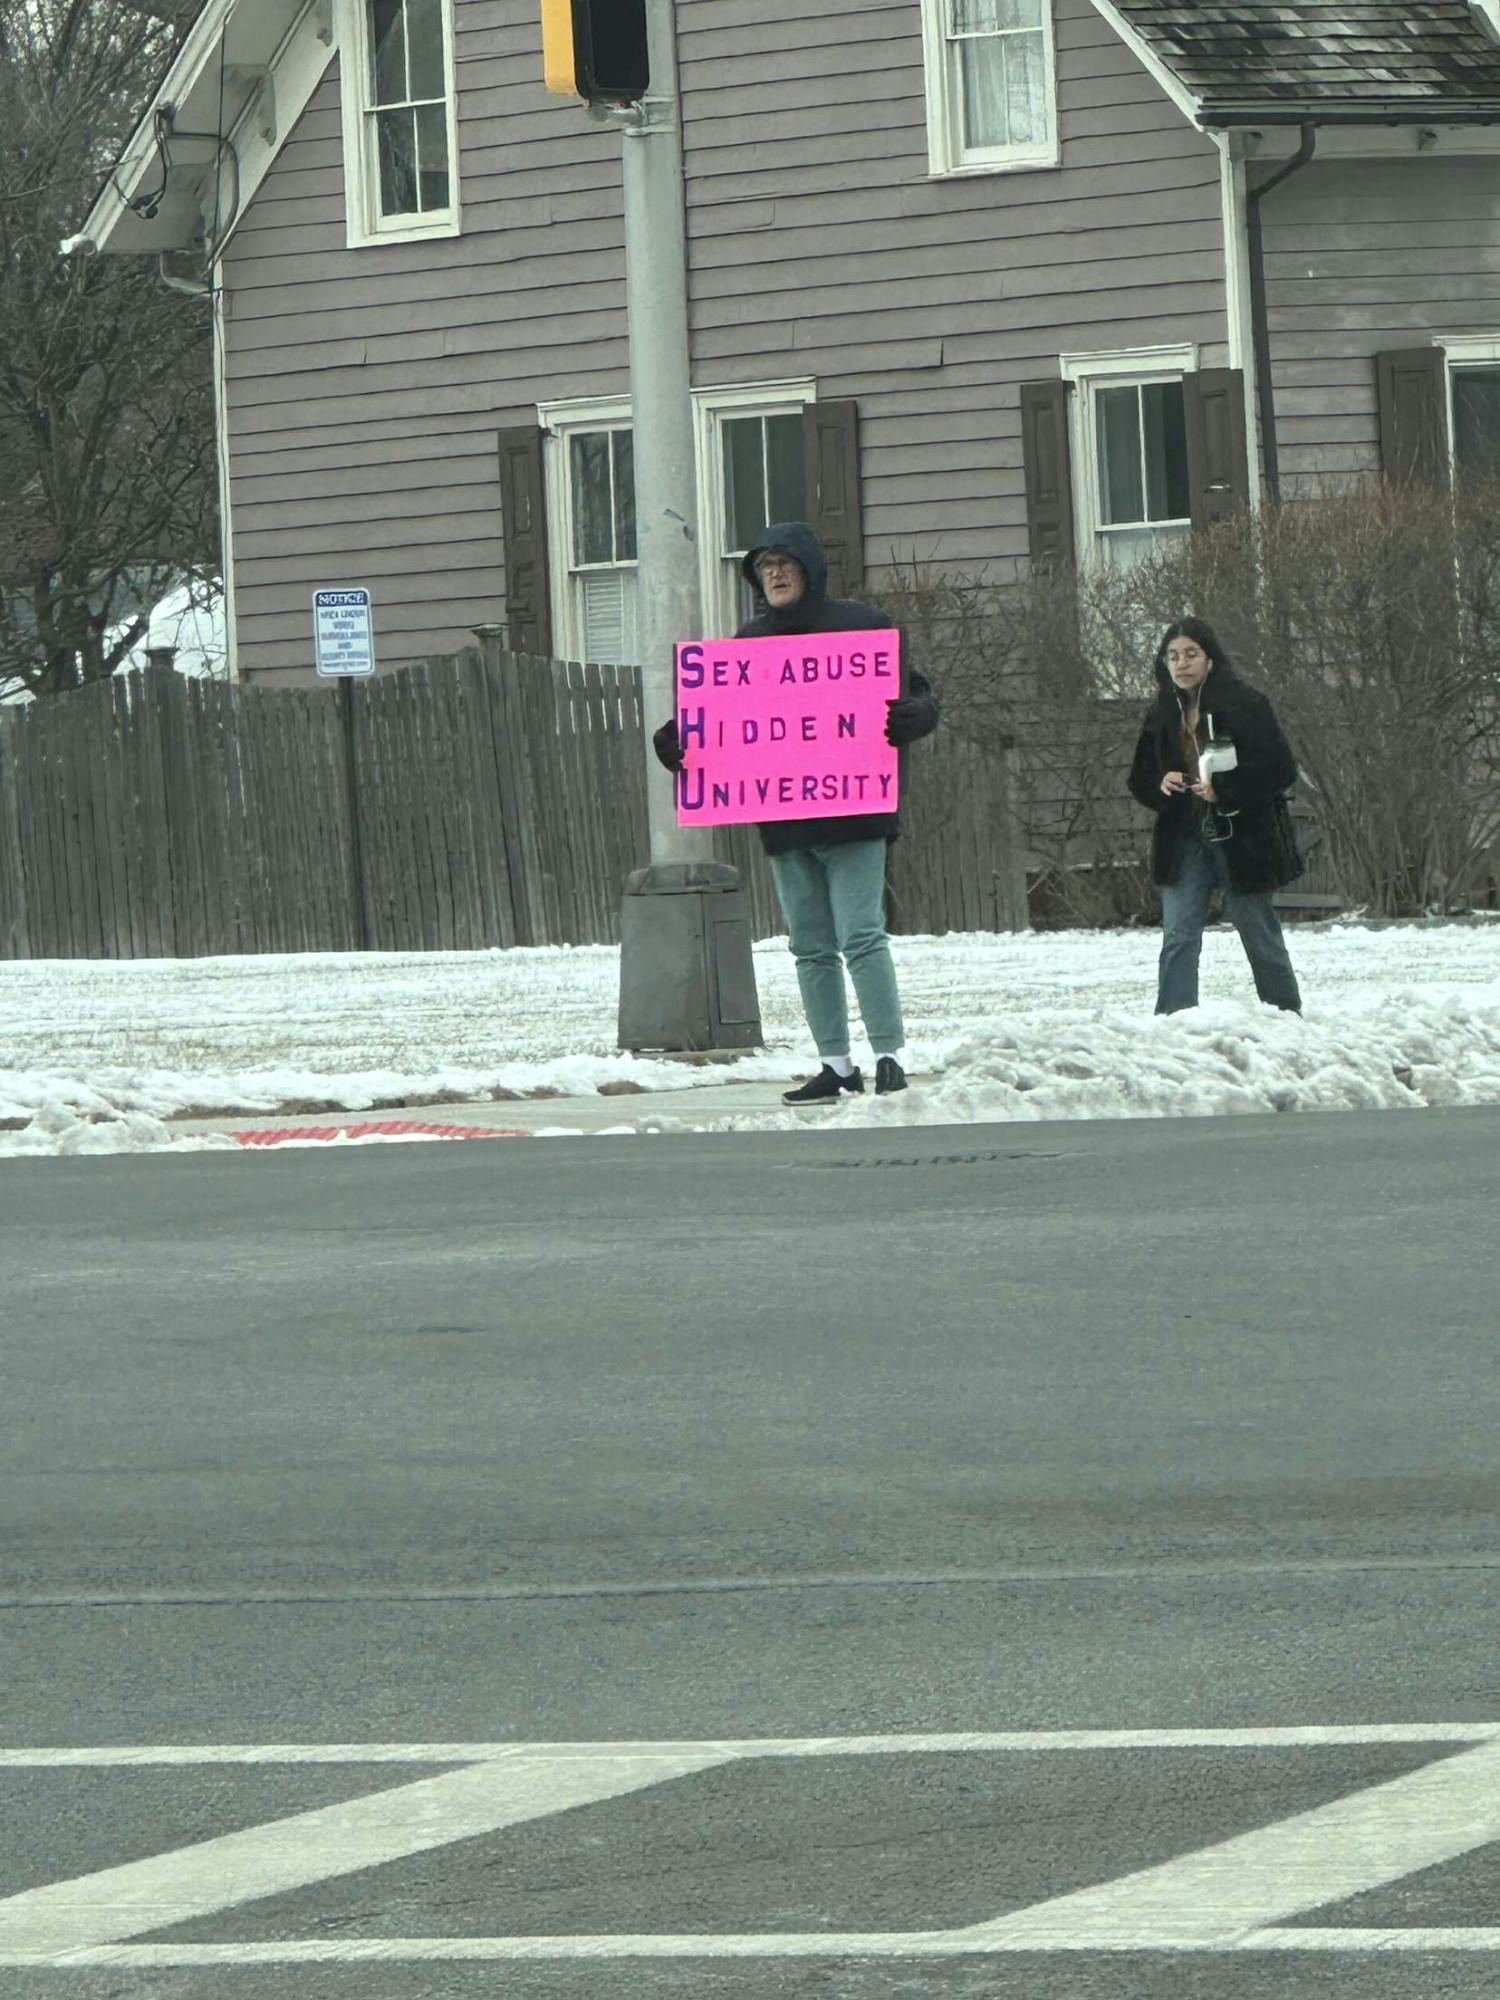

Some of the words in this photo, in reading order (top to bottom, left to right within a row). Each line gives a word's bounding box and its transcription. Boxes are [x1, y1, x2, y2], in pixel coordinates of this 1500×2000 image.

[318, 593, 364, 605] NOTICE
[680, 645, 751, 689] SEX
[779, 652, 891, 685] ABUSE
[680, 707, 855, 750] HIDDEN
[680, 767, 892, 810] UNIVERSITY
